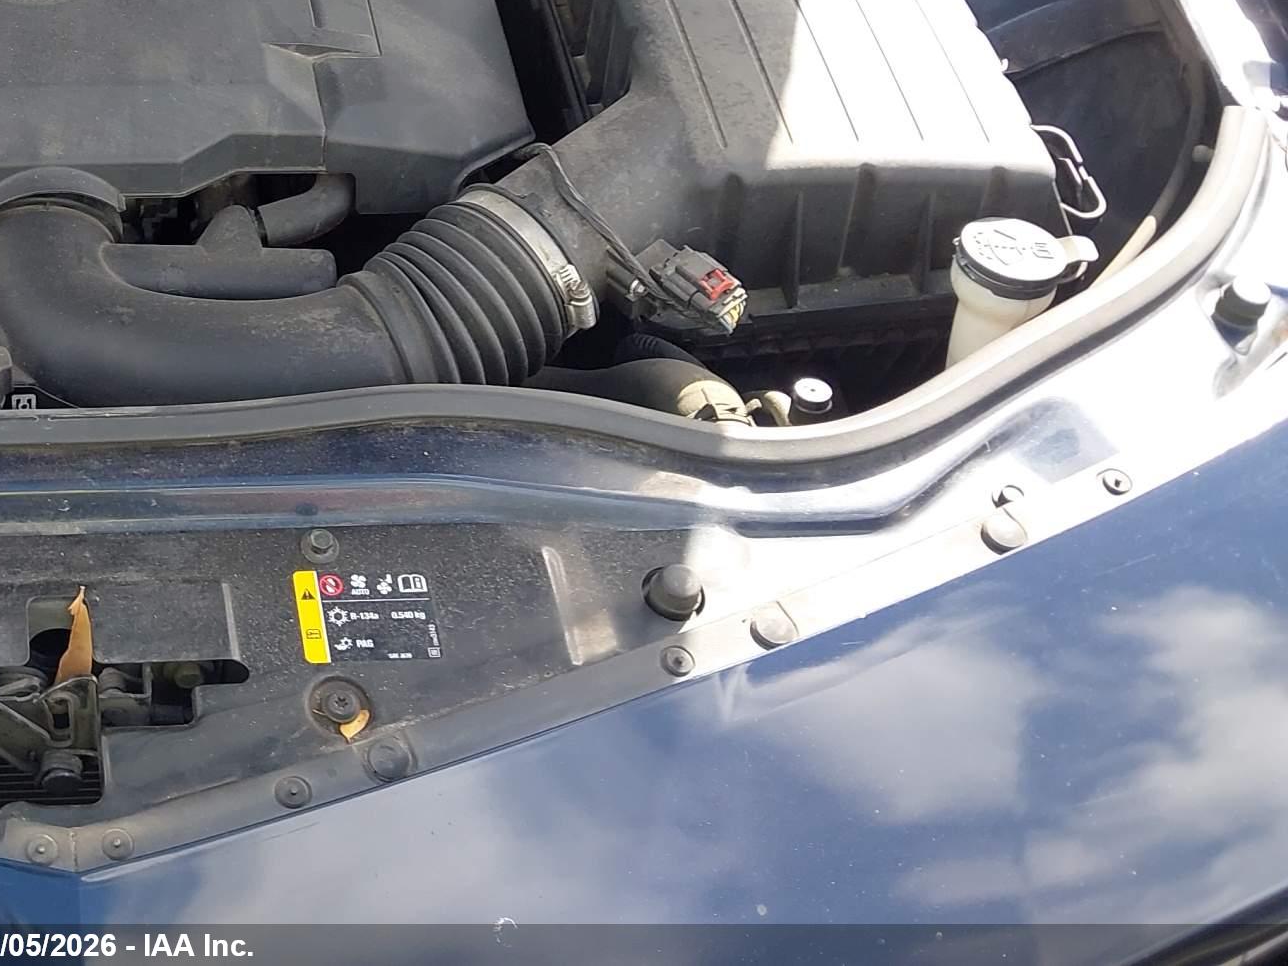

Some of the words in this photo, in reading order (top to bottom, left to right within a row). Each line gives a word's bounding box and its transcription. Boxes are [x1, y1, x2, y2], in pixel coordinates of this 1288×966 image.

[350, 611, 379, 620] R-134a
[414, 611, 426, 620] kg
[355, 639, 374, 648] PAG
